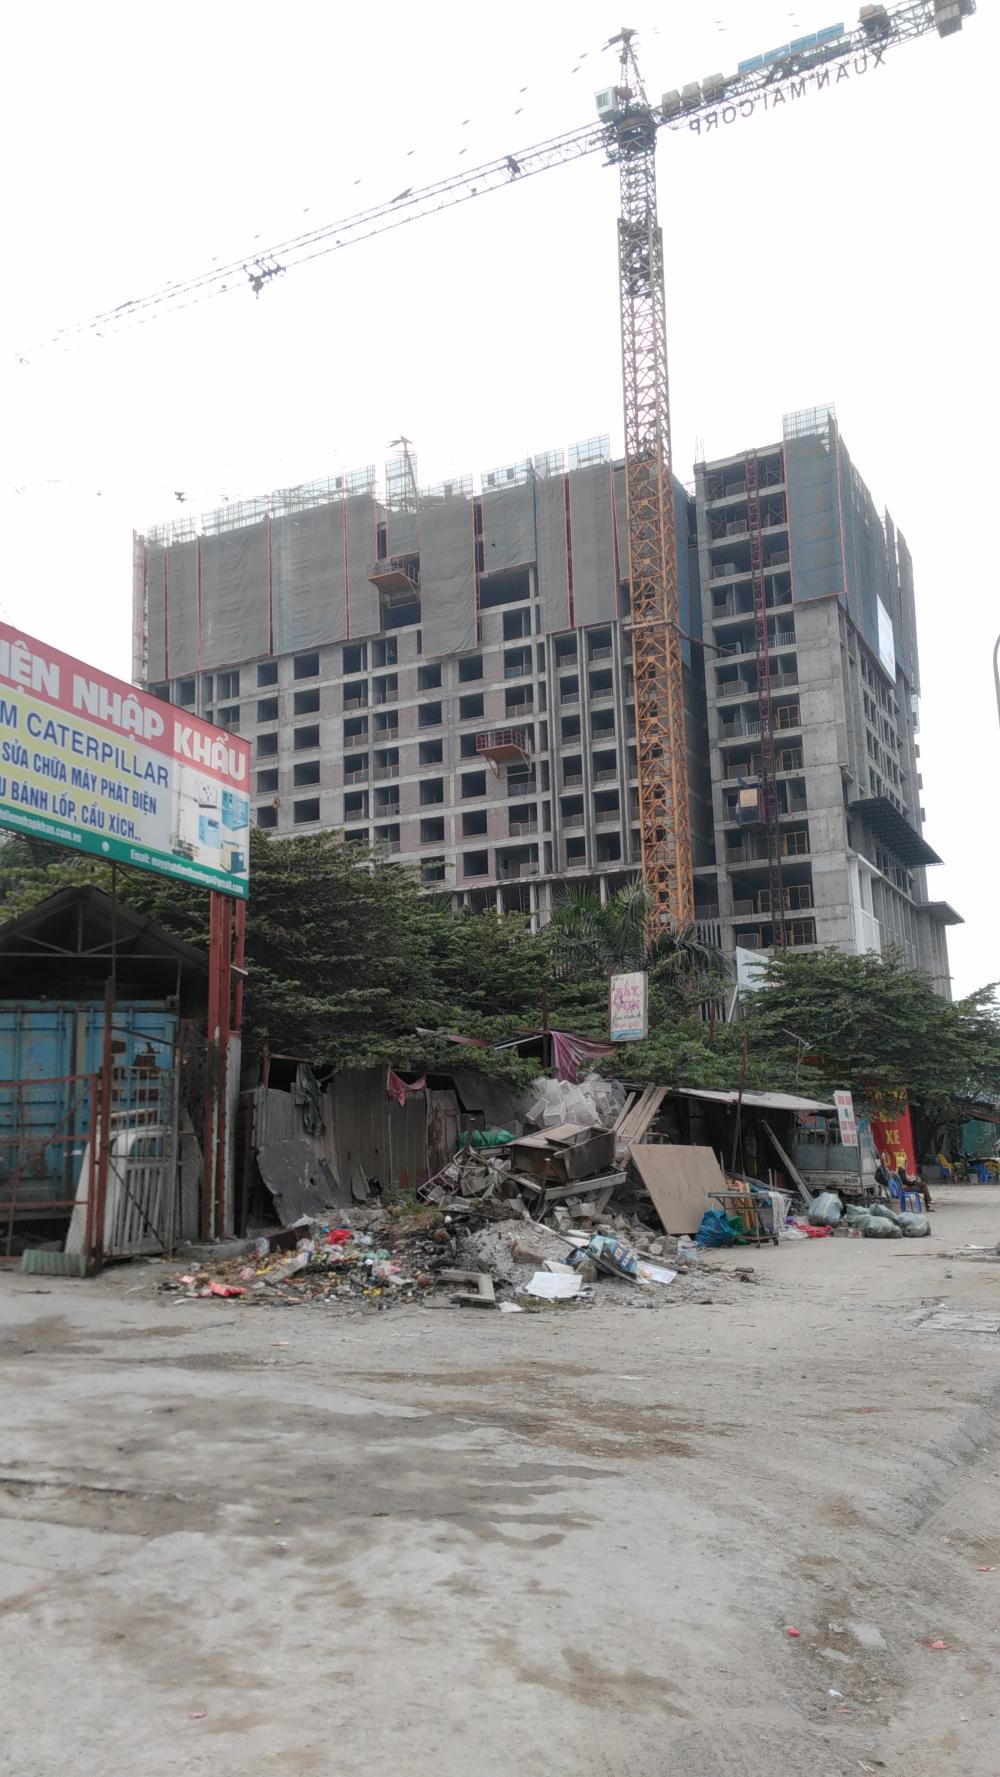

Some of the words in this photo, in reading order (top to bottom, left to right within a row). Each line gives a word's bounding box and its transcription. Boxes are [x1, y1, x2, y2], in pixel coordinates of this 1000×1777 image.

[27, 712, 169, 789] CATERPILLAR
[73, 676, 165, 741] NHẬP
[173, 721, 246, 782] KHẨU
[2, 739, 29, 770] SỬA
[33, 753, 67, 784] CHỮA
[71, 767, 98, 793] MÁY
[101, 779, 130, 806] PHÁT
[132, 790, 158, 816] ĐIỆN
[11, 780, 49, 812] BÁNH
[885, 1129, 901, 1145] XE
